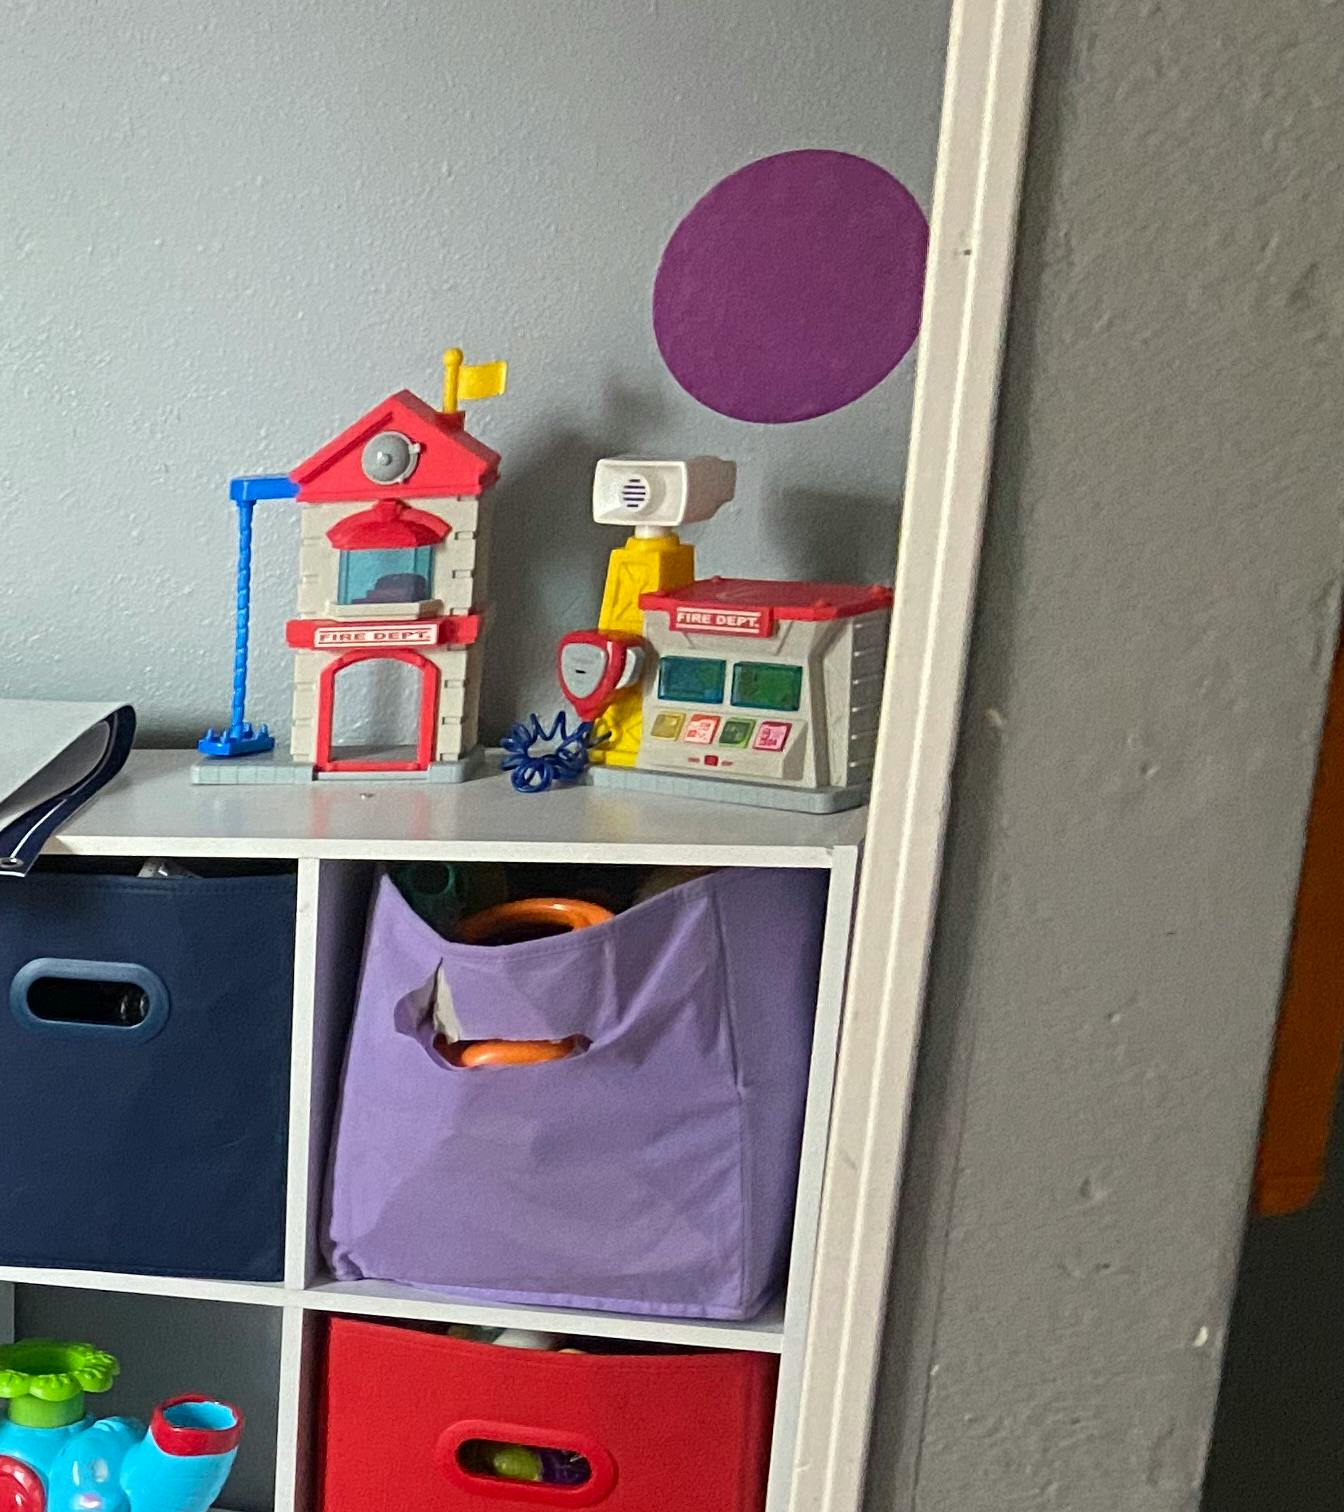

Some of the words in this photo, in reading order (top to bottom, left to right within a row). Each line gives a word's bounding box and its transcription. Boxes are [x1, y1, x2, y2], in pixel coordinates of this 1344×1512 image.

[676, 612, 712, 624] FIRE
[716, 614, 761, 628] DEPT.
[319, 632, 366, 642] FIRE
[373, 631, 431, 641] DEPT.
